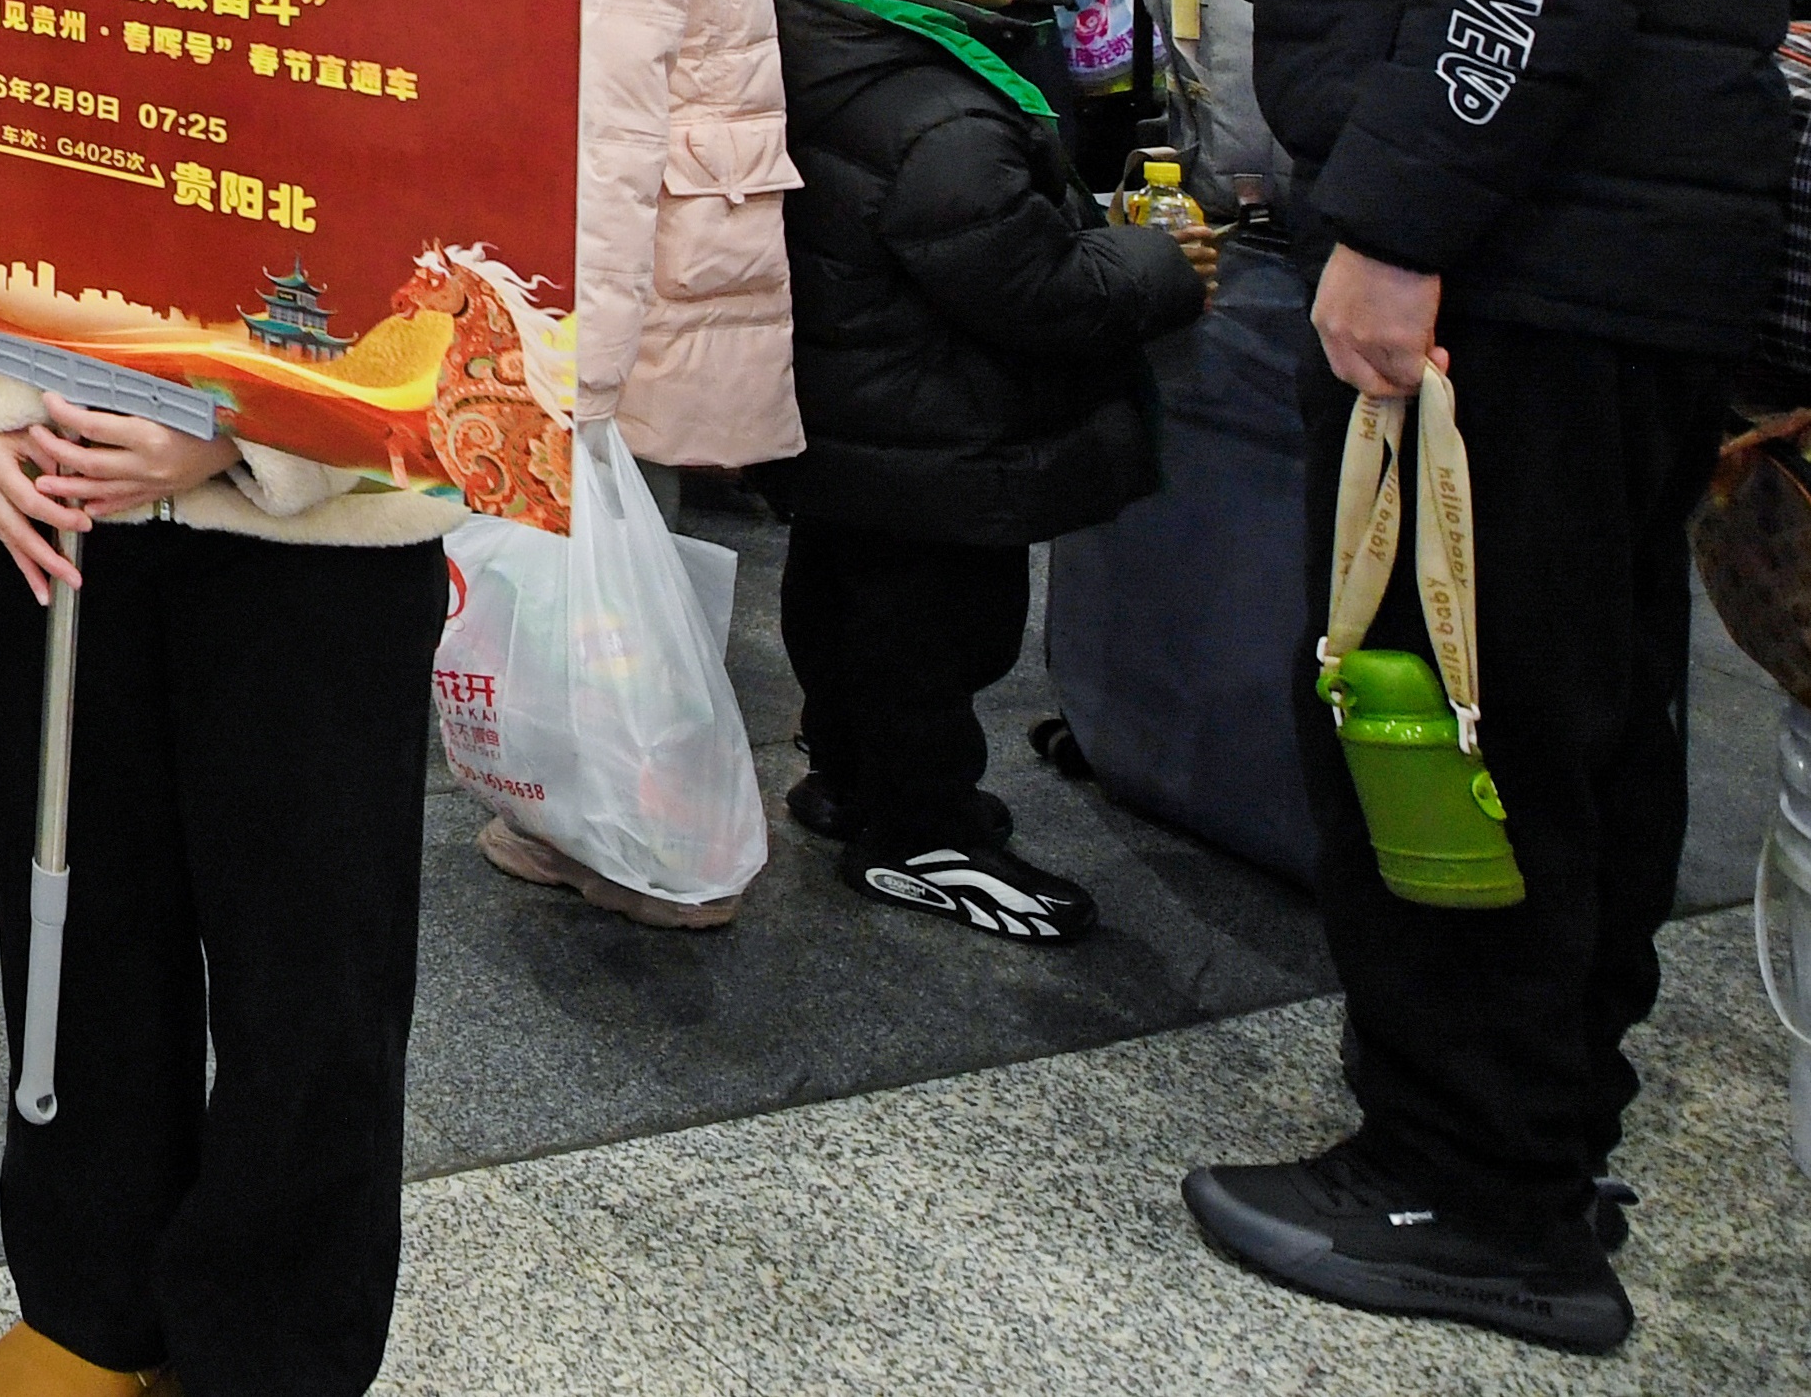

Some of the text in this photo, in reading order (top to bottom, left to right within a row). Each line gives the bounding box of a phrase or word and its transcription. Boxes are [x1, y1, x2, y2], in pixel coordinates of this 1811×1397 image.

[249, 43, 419, 102] 春节直通车
[139, 103, 229, 144] 07:25
[171, 160, 317, 233] 贵阳北
[1436, 466, 1463, 525] hello
